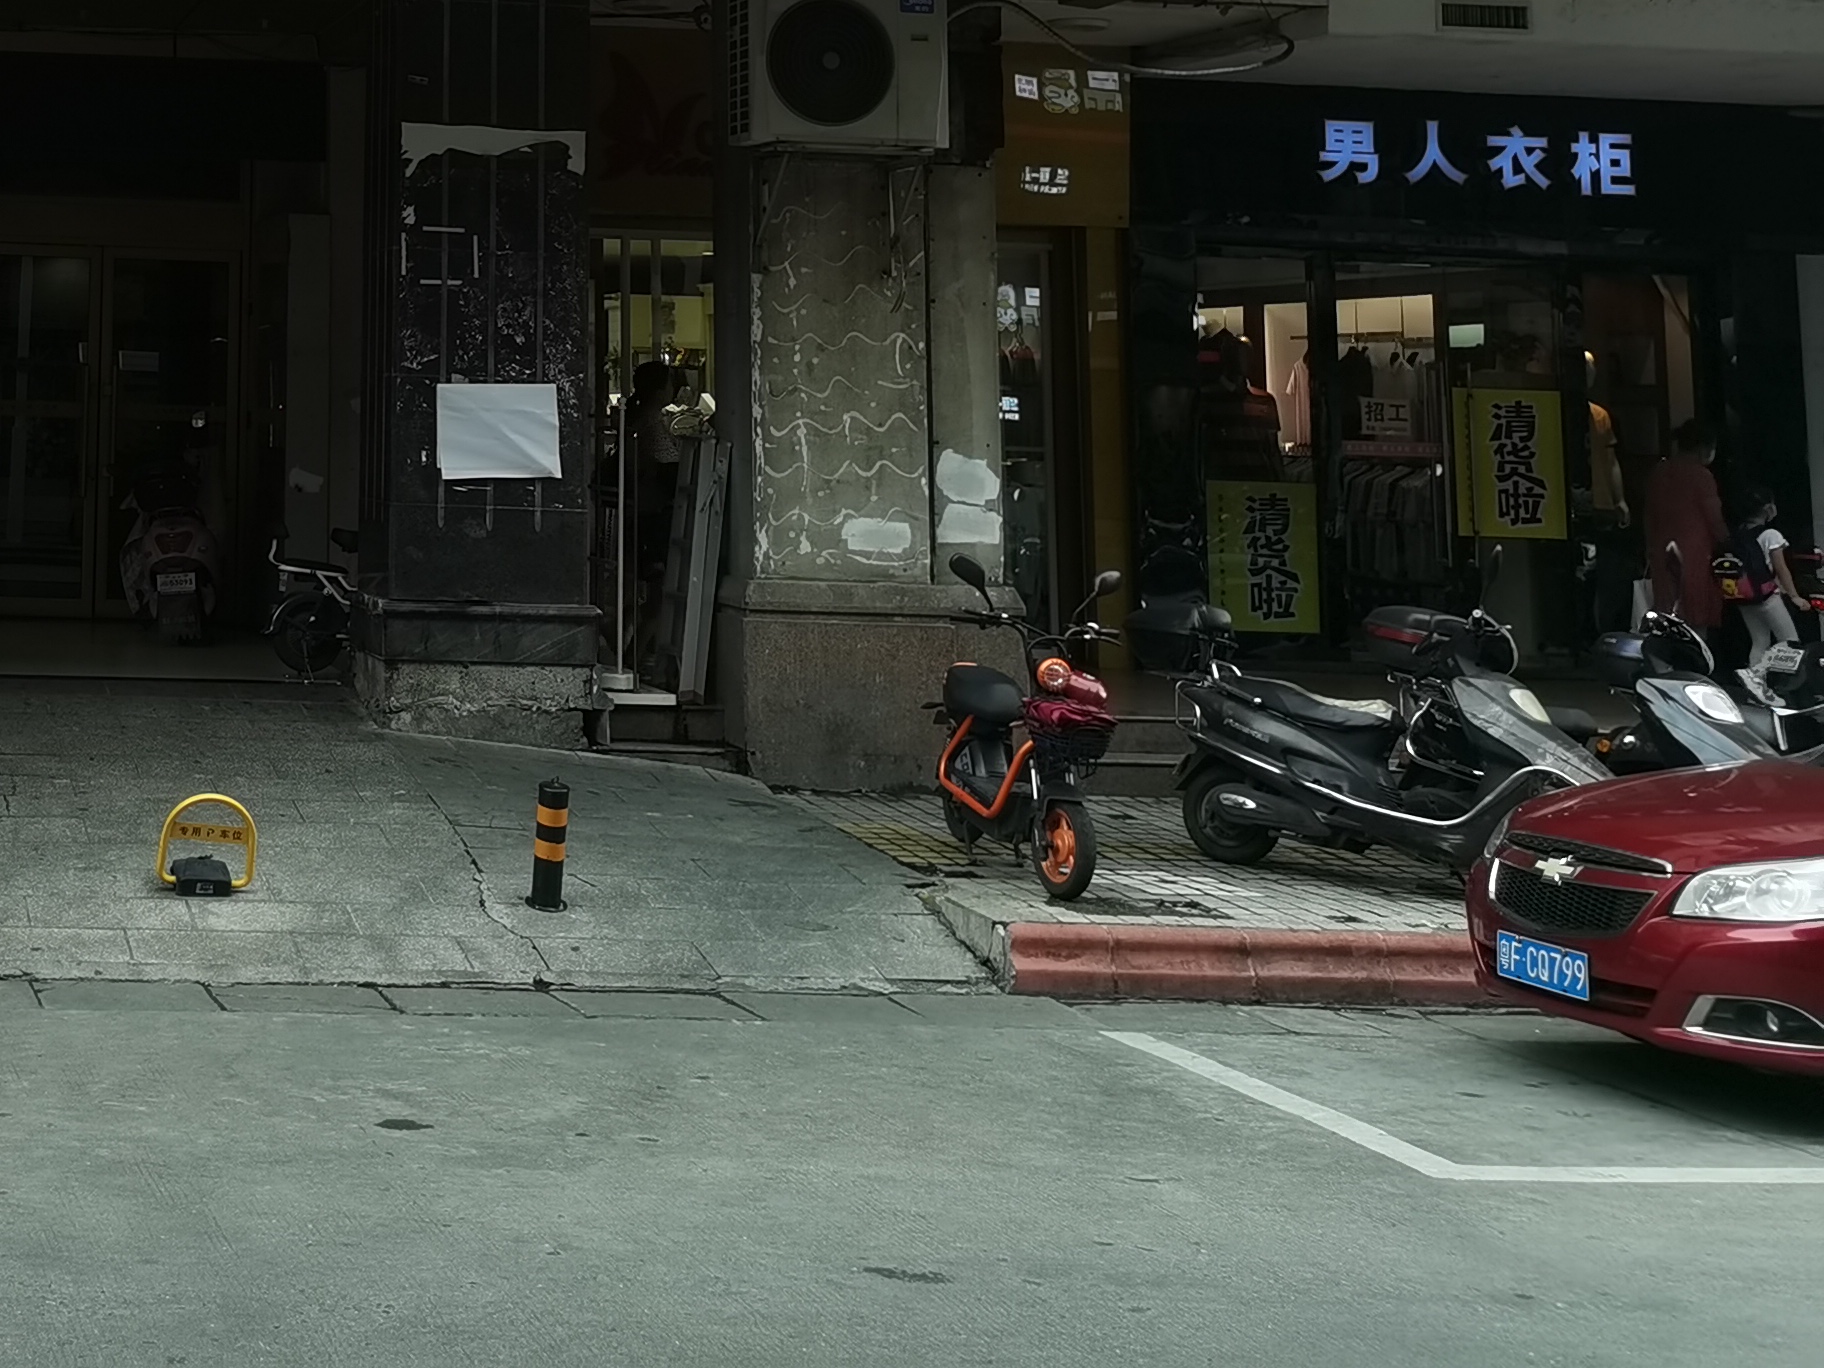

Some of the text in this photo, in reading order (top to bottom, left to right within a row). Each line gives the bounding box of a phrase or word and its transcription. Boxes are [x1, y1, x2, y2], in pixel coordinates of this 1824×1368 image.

[1317, 118, 1637, 197] 男人衣柜
[1364, 401, 1408, 422] 招工
[1488, 400, 1547, 525] 清货啦
[1242, 492, 1301, 621] 清货啦
